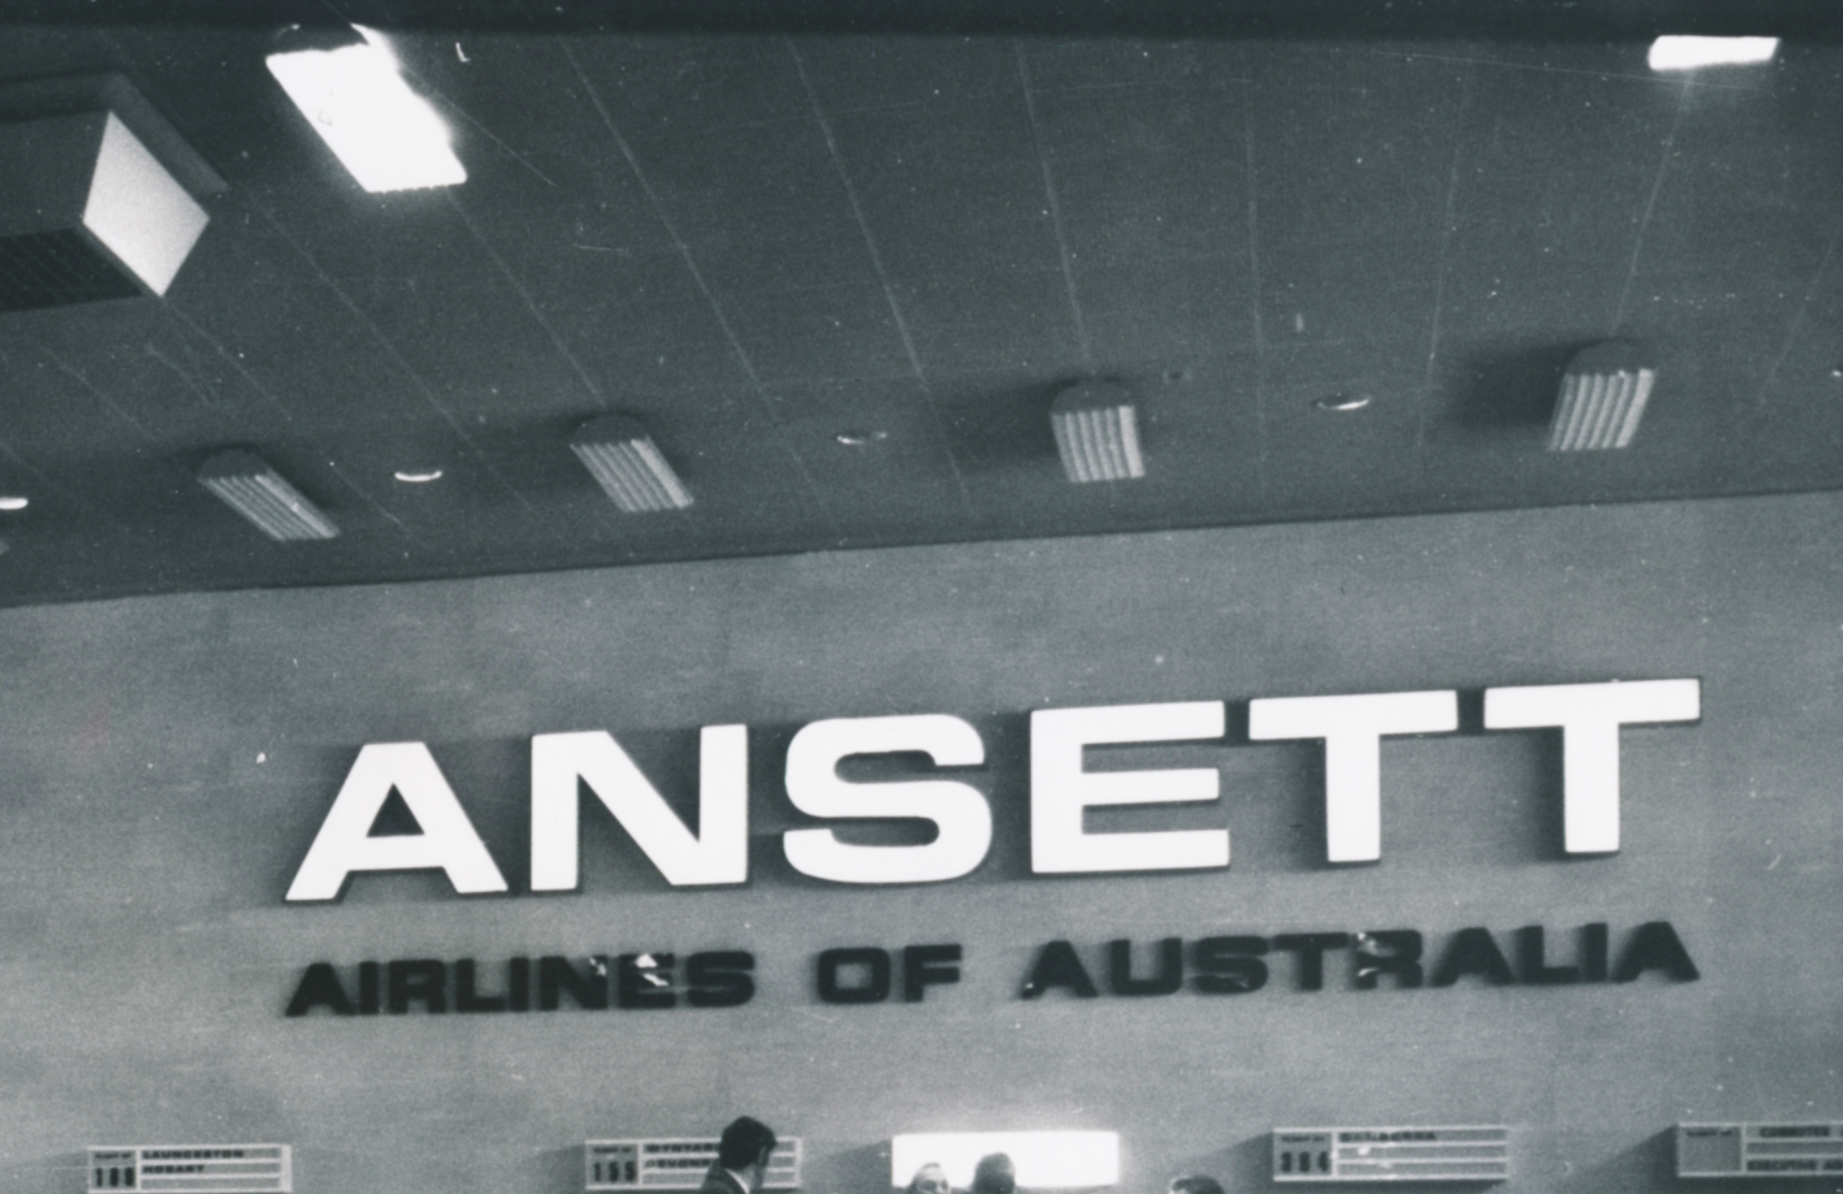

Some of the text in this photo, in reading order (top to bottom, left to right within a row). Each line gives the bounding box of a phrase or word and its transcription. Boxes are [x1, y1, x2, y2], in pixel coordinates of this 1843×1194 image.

[285, 676, 1702, 901] ANSETT
[286, 921, 1699, 1020] AIRLINES OF AUSTRALIA
[644, 1143, 719, 1153] WYNYAR
[142, 1150, 245, 1159] LAUNCESTON
[142, 1165, 206, 1174] HOBART
